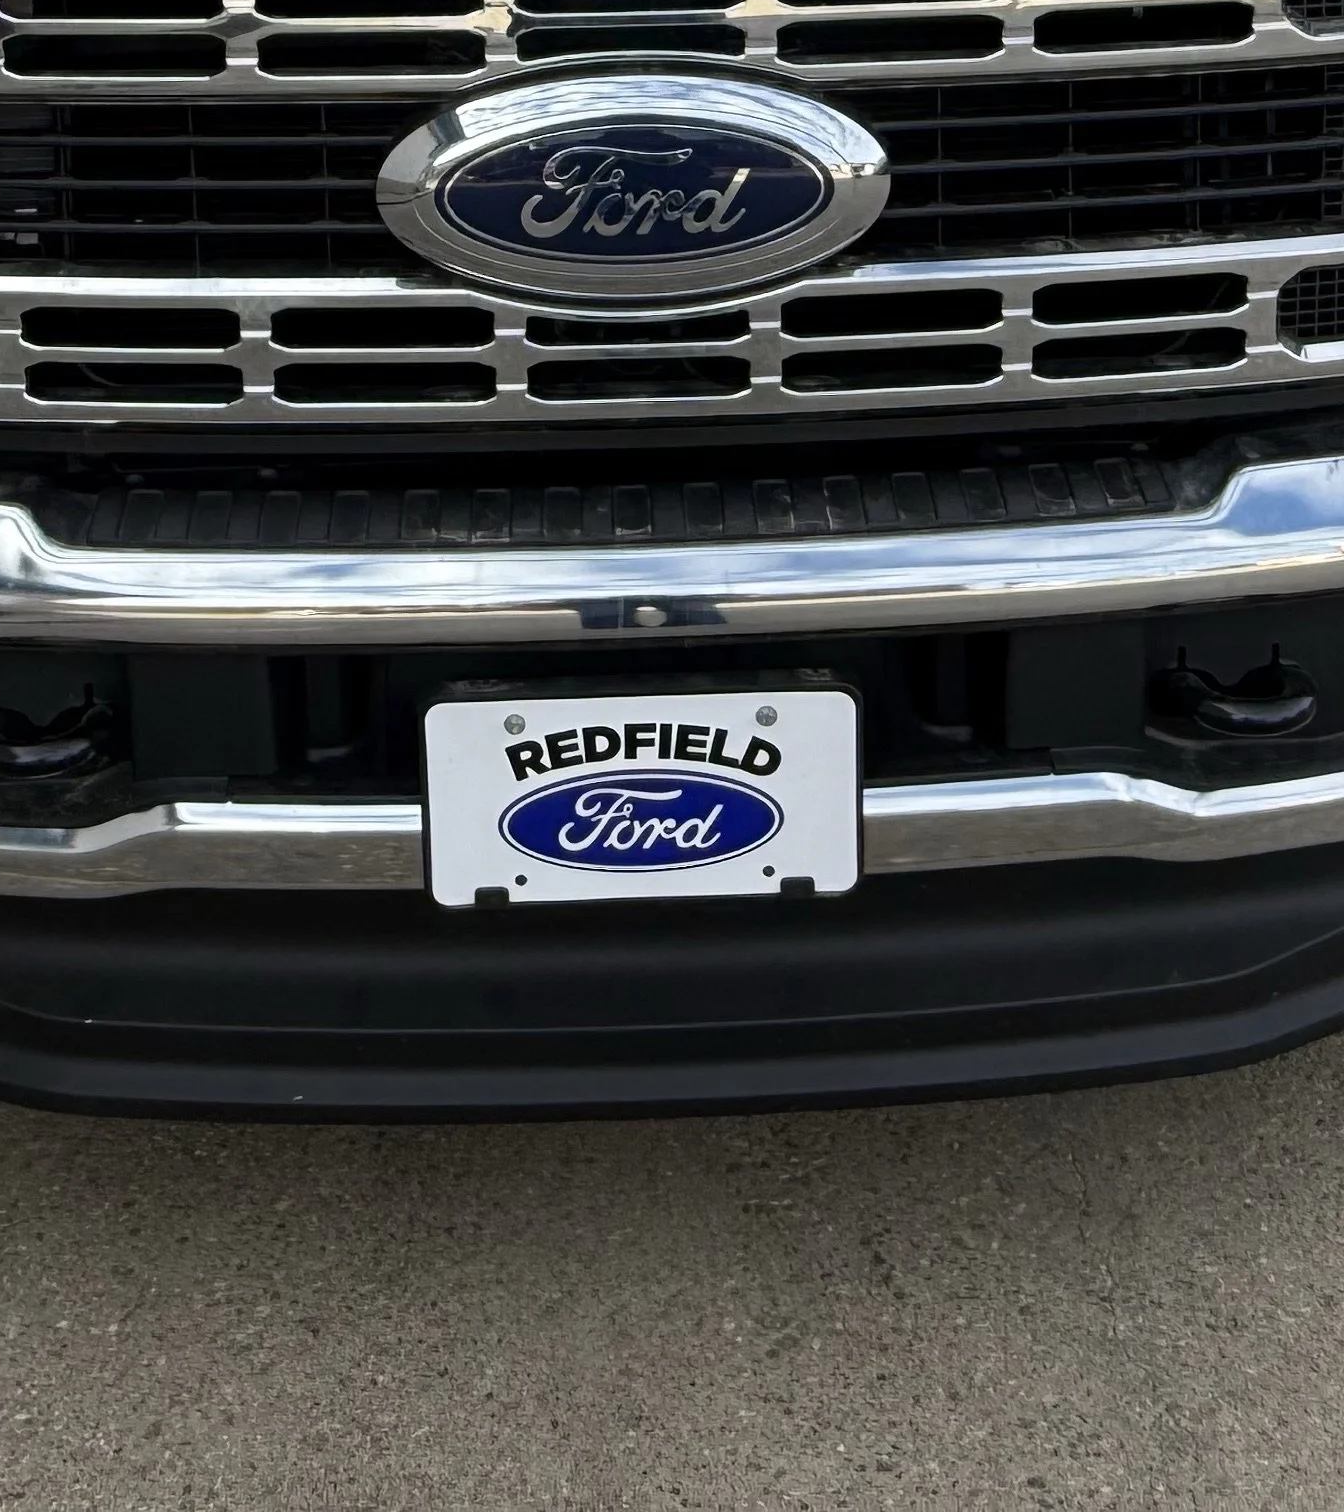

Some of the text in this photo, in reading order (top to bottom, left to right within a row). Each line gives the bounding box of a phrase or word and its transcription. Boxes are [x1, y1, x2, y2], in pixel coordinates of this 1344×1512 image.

[519, 145, 752, 239] Ford
[504, 722, 783, 782] REDFIELD
[557, 787, 725, 852] Ford
